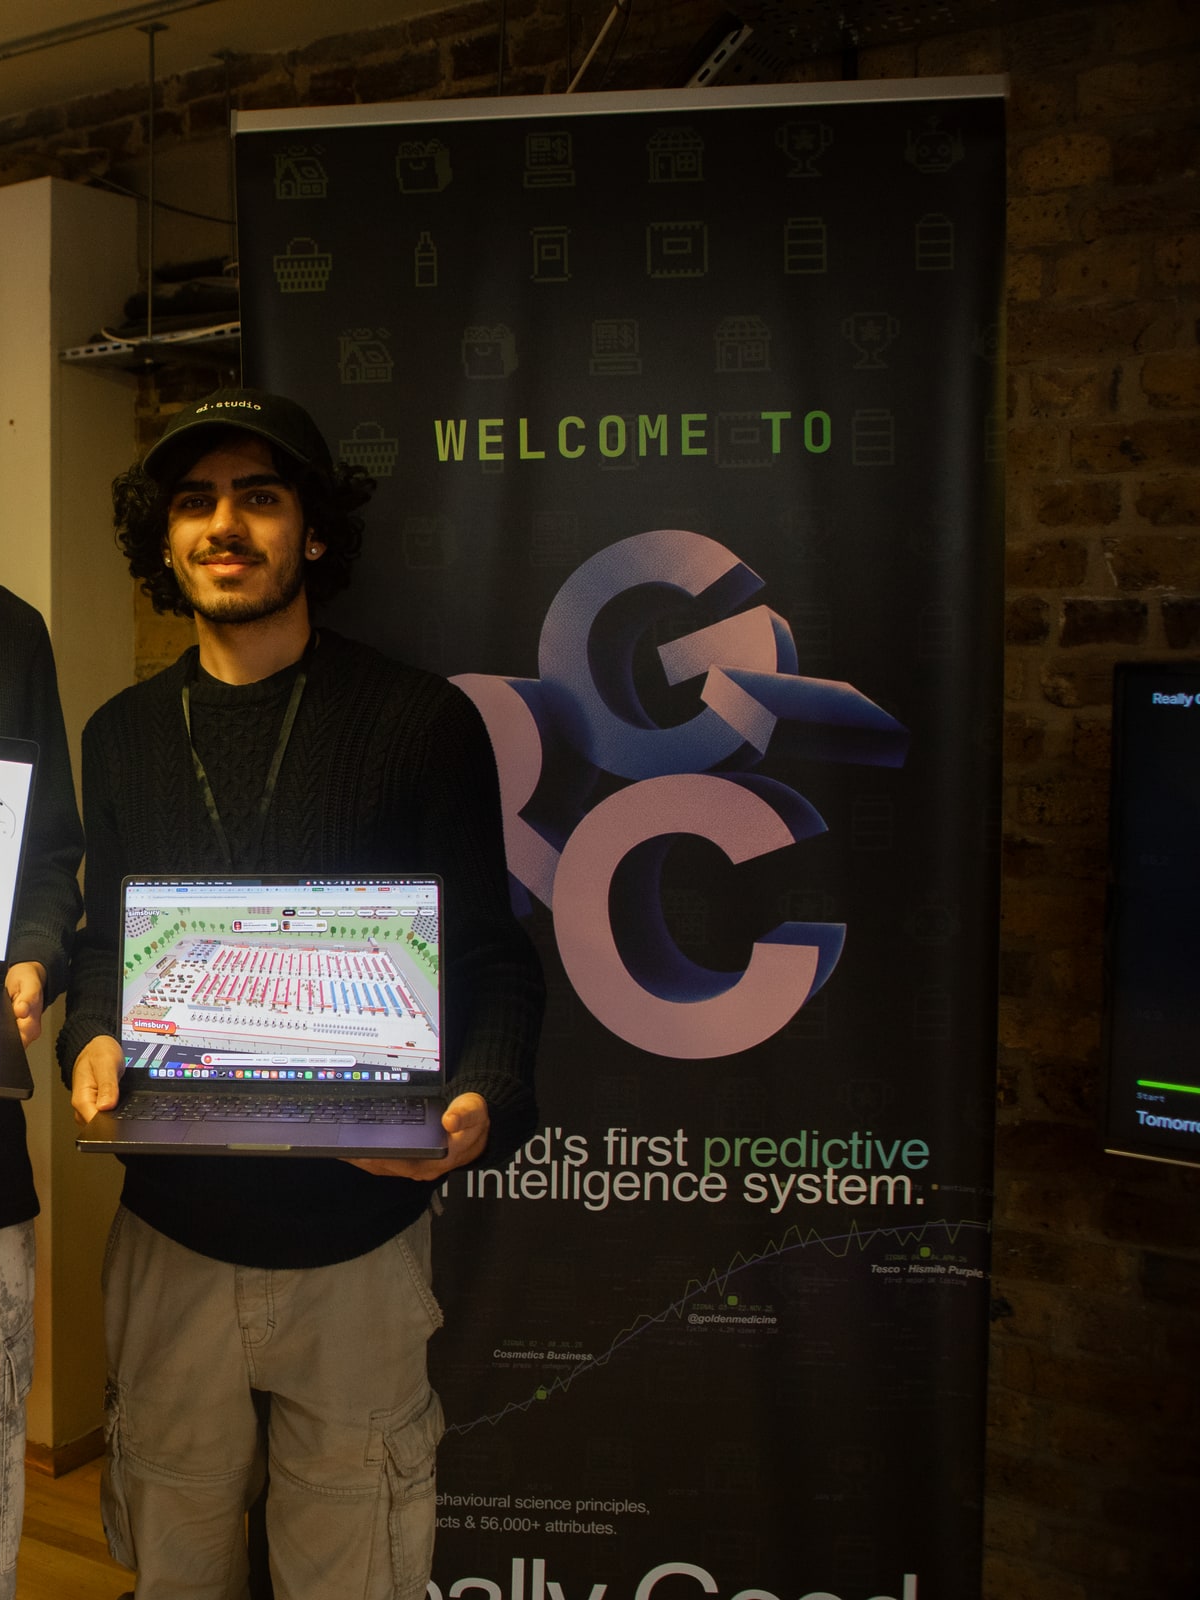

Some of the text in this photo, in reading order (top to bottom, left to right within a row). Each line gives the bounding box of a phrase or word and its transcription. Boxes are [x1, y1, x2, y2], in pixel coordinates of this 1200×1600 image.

[434, 410, 832, 461] WELCOME TO
[1152, 692, 1193, 707] Really
[134, 1019, 170, 1030] simsbury
[603, 1127, 689, 1167] first
[704, 1131, 930, 1176] predictive
[467, 1160, 926, 1214] intelligence system.
[871, 1264, 985, 1279] Tesco Hismile Purple
[687, 1313, 778, 1325] @goldenmedicine
[493, 1349, 593, 1361] Cosmetics Business
[435, 1493, 650, 1515] ehavioural science principles,
[464, 1515, 476, 1529] &
[480, 1516, 541, 1532] 56,000+
[544, 1520, 617, 1535] attributes.
